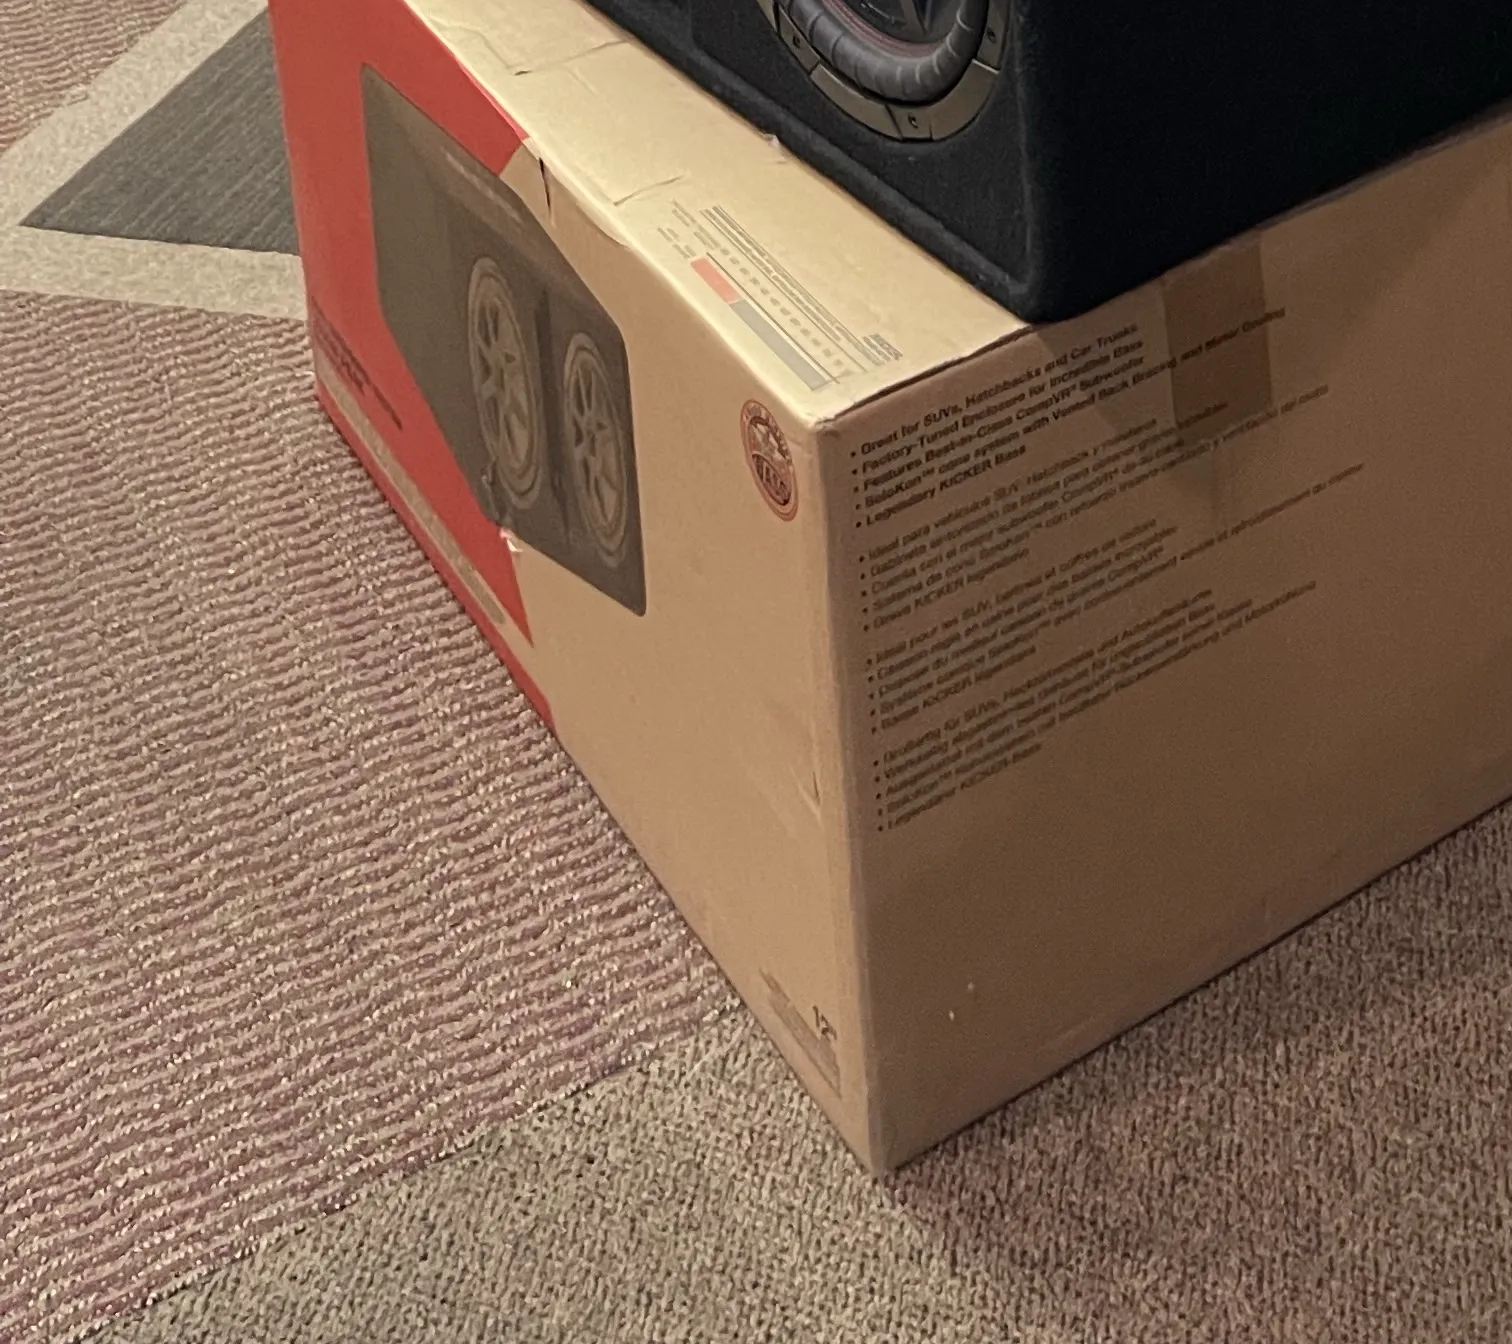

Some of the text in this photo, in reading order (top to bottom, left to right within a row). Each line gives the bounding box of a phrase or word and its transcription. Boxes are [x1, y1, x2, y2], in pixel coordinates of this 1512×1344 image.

[860, 430, 898, 456] Great
[901, 418, 920, 439] for
[965, 367, 1042, 408] Hatchbacks
[1044, 354, 1068, 373] and
[1070, 344, 1093, 361] Car
[1022, 415, 1050, 436] with
[939, 460, 993, 492] KICKER
